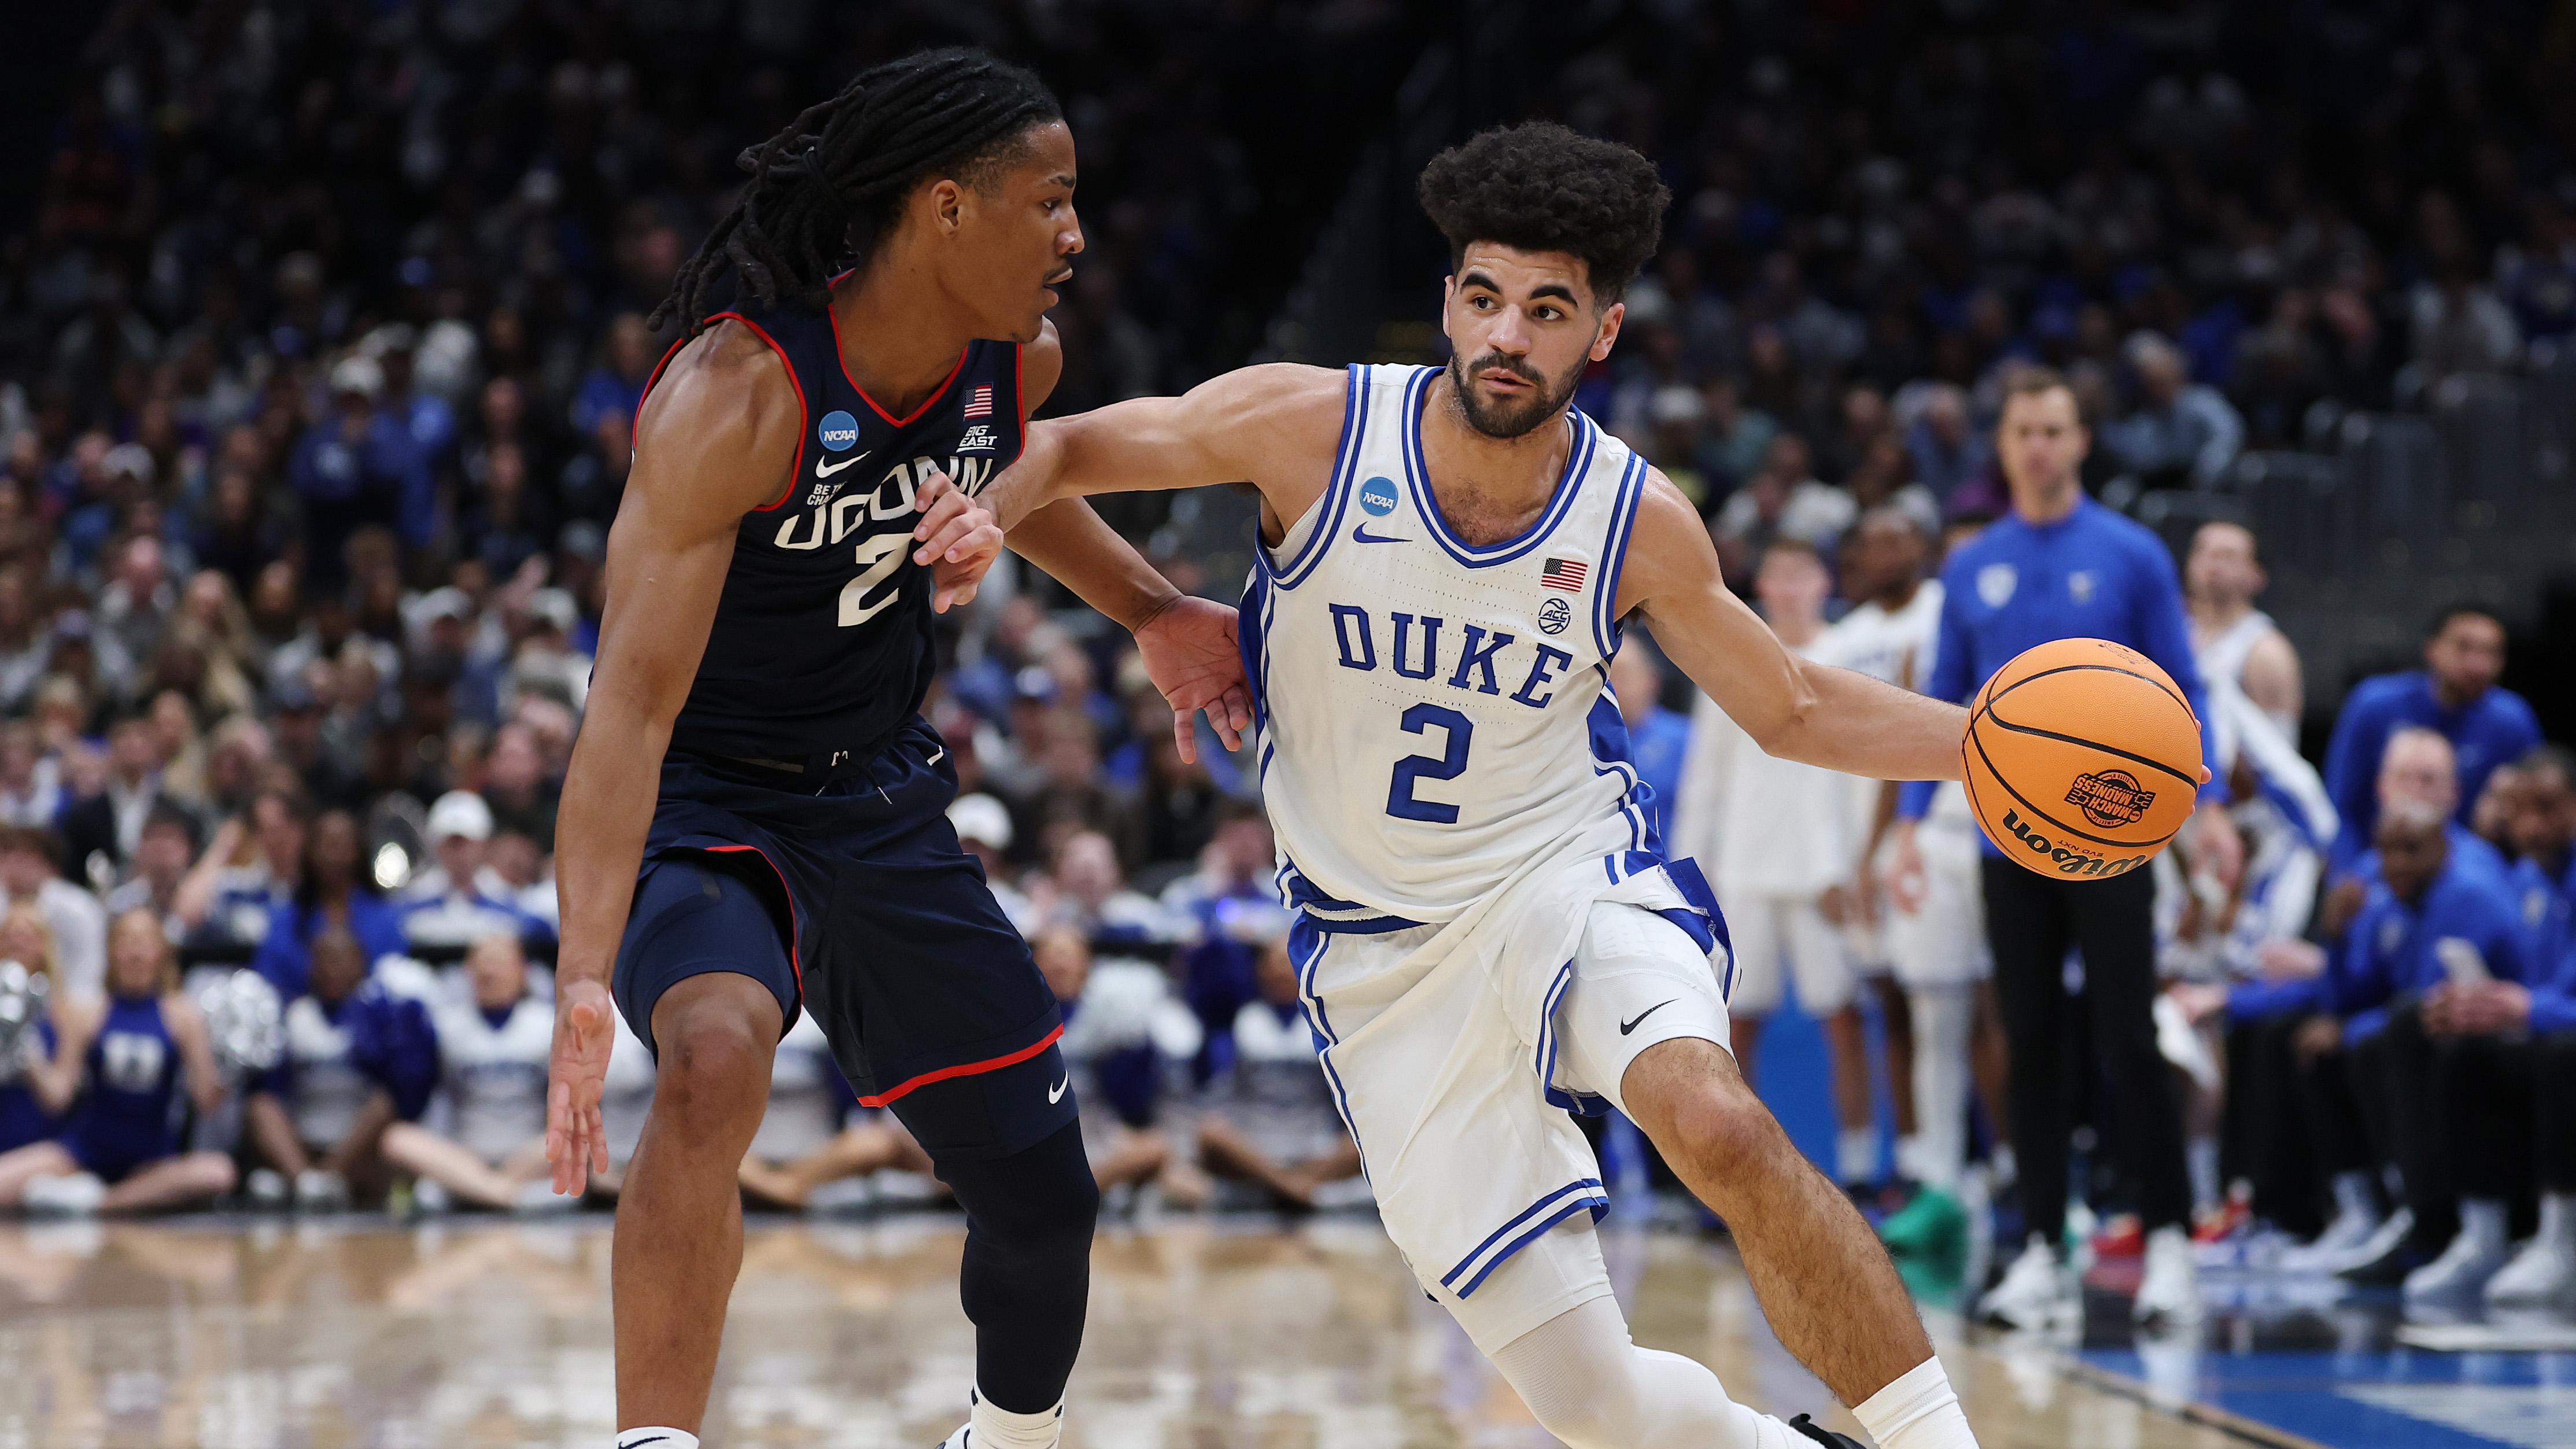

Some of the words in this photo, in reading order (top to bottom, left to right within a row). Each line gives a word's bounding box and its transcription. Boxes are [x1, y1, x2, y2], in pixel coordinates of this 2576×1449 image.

[824, 429, 856, 441] NCAA
[965, 425, 990, 437] BIG
[959, 436, 998, 447] EAST
[813, 484, 831, 495] BE
[1363, 491, 1394, 509] NCAA
[838, 532, 914, 628] 2
[1542, 610, 1570, 621] ACC
[1328, 602, 1573, 709] DUKE
[1385, 702, 1474, 824] 2
[2075, 776, 2132, 805] MADNESS
[2088, 798, 2134, 819] MARCH
[2002, 808, 2146, 876] Wilson
[2057, 839, 2080, 851] NXT
[2082, 849, 2105, 857] EVO
